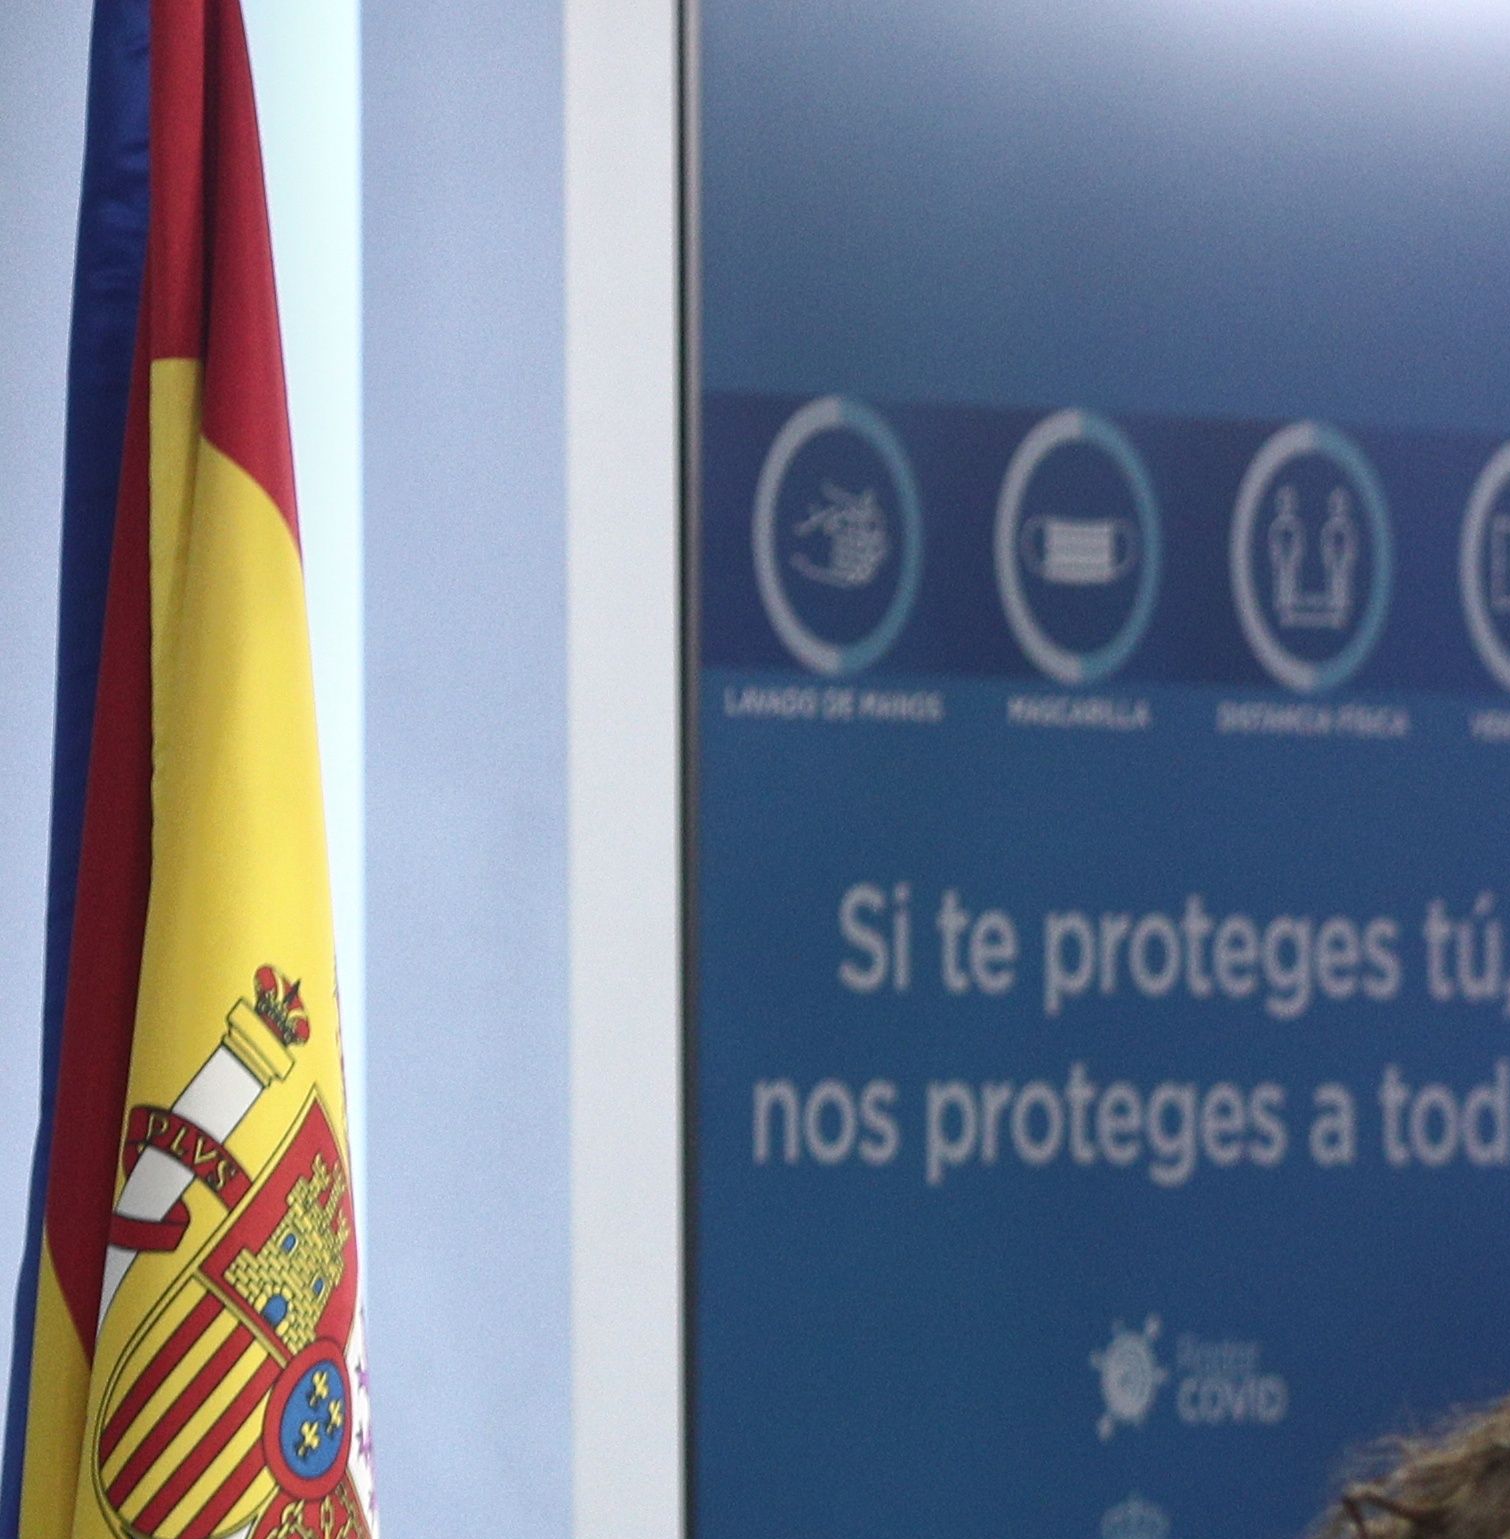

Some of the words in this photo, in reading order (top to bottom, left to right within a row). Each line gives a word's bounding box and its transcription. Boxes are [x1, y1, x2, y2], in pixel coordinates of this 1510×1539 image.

[838, 882, 913, 992] Si
[937, 888, 1018, 994] te
[1044, 893, 1401, 1019] proteges
[752, 1077, 900, 1166] nos
[925, 1061, 1289, 1187] proteges
[1308, 1083, 1355, 1166] a
[1175, 1373, 1289, 1424] COVID
